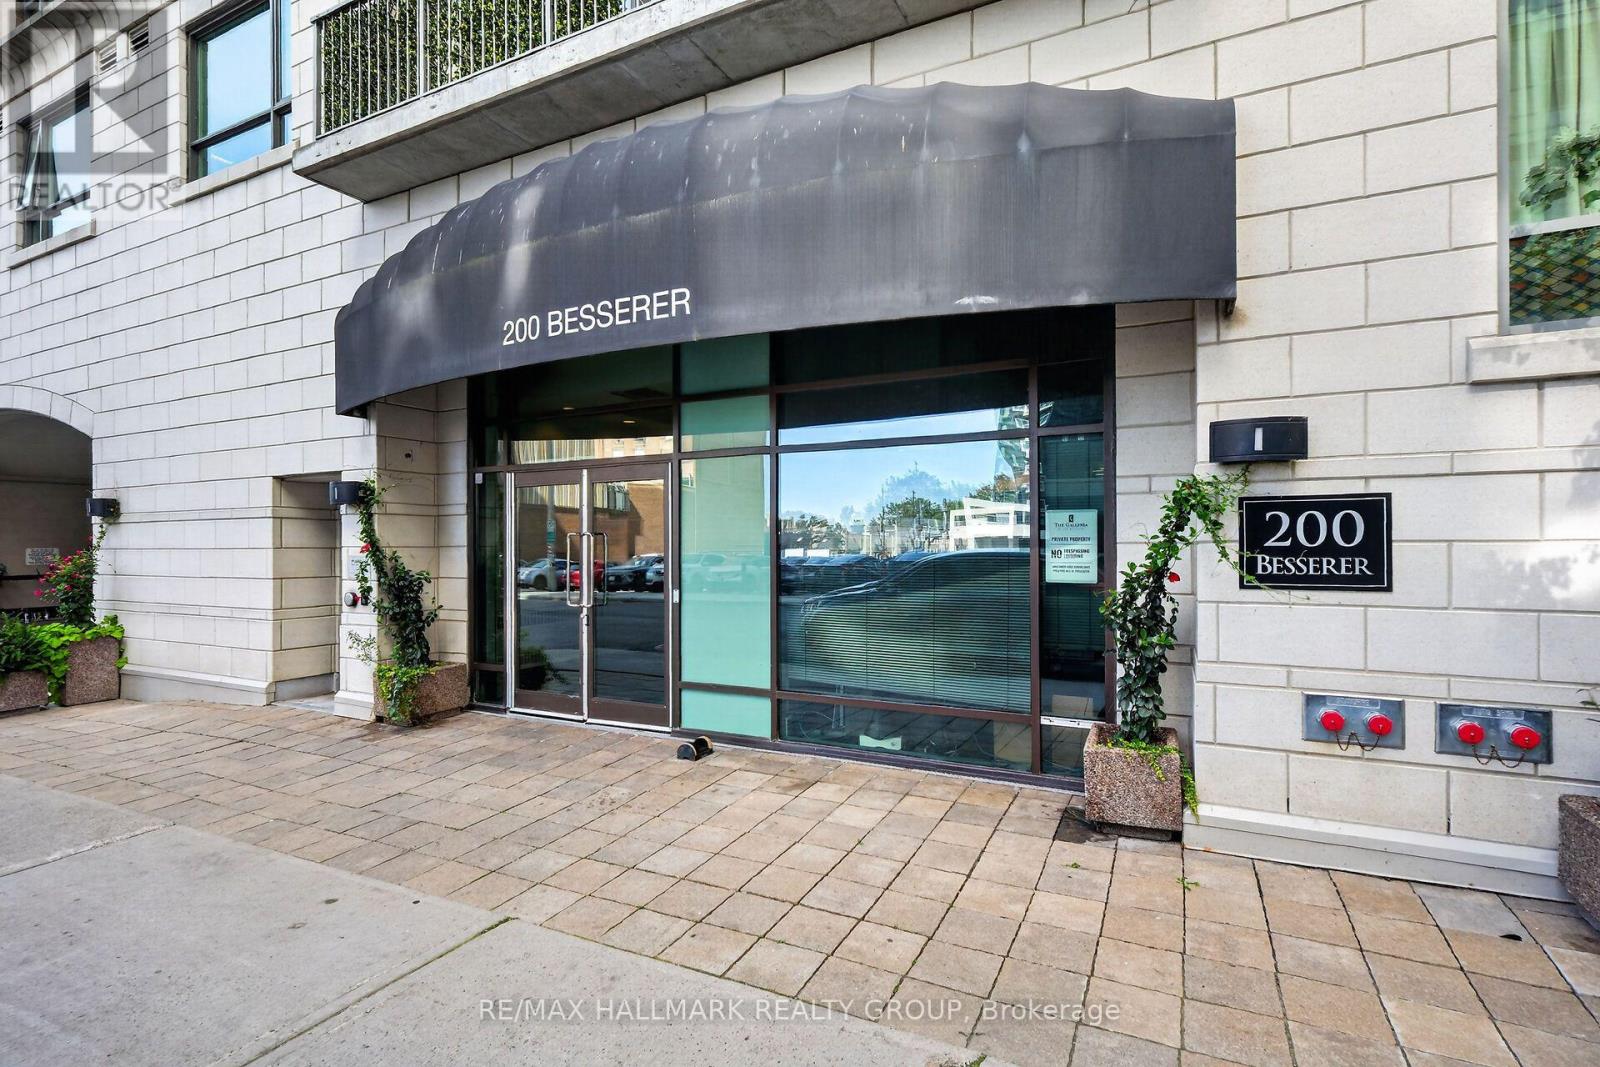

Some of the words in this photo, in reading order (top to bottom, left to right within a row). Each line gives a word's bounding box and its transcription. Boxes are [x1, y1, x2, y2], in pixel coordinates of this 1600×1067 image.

[502, 315, 540, 346] 200
[547, 287, 691, 337] BESSERER
[1263, 509, 1365, 547] 200
[1051, 549, 1063, 559] NO
[1256, 554, 1375, 575] BESSERER
